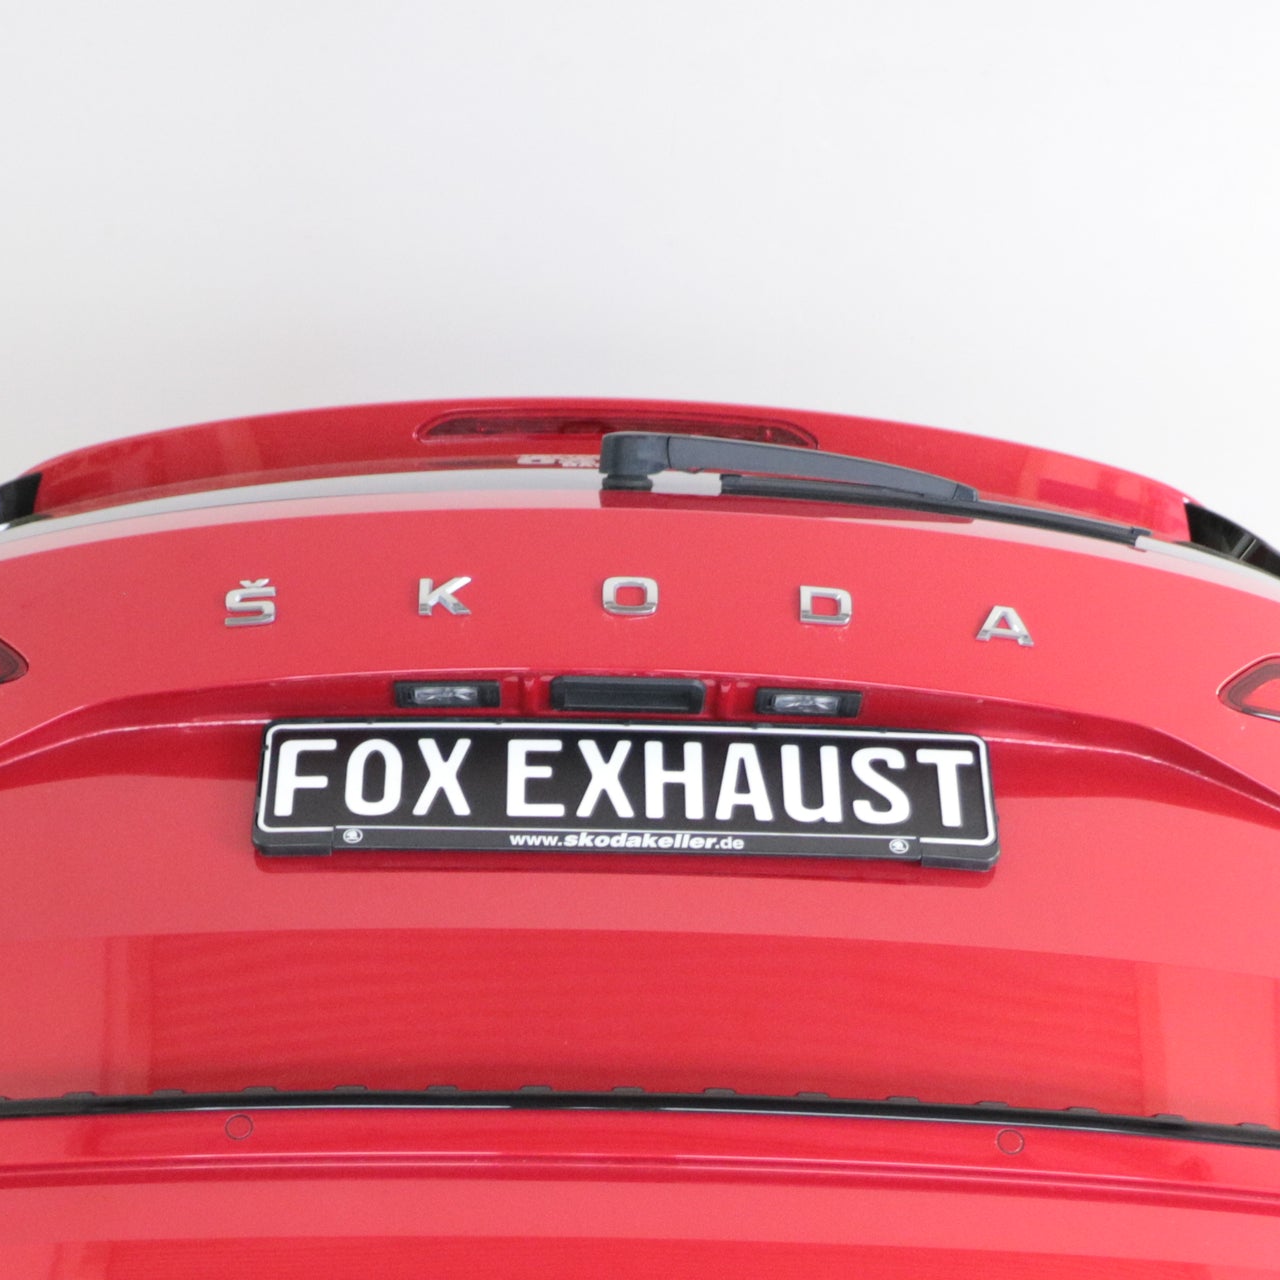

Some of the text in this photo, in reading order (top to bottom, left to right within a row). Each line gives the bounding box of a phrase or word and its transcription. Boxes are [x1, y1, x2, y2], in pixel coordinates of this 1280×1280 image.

[223, 576, 1034, 647] ŠKODA
[273, 737, 975, 830] FOX EXHAUST
[509, 832, 745, 850] www.skodakeller.de
